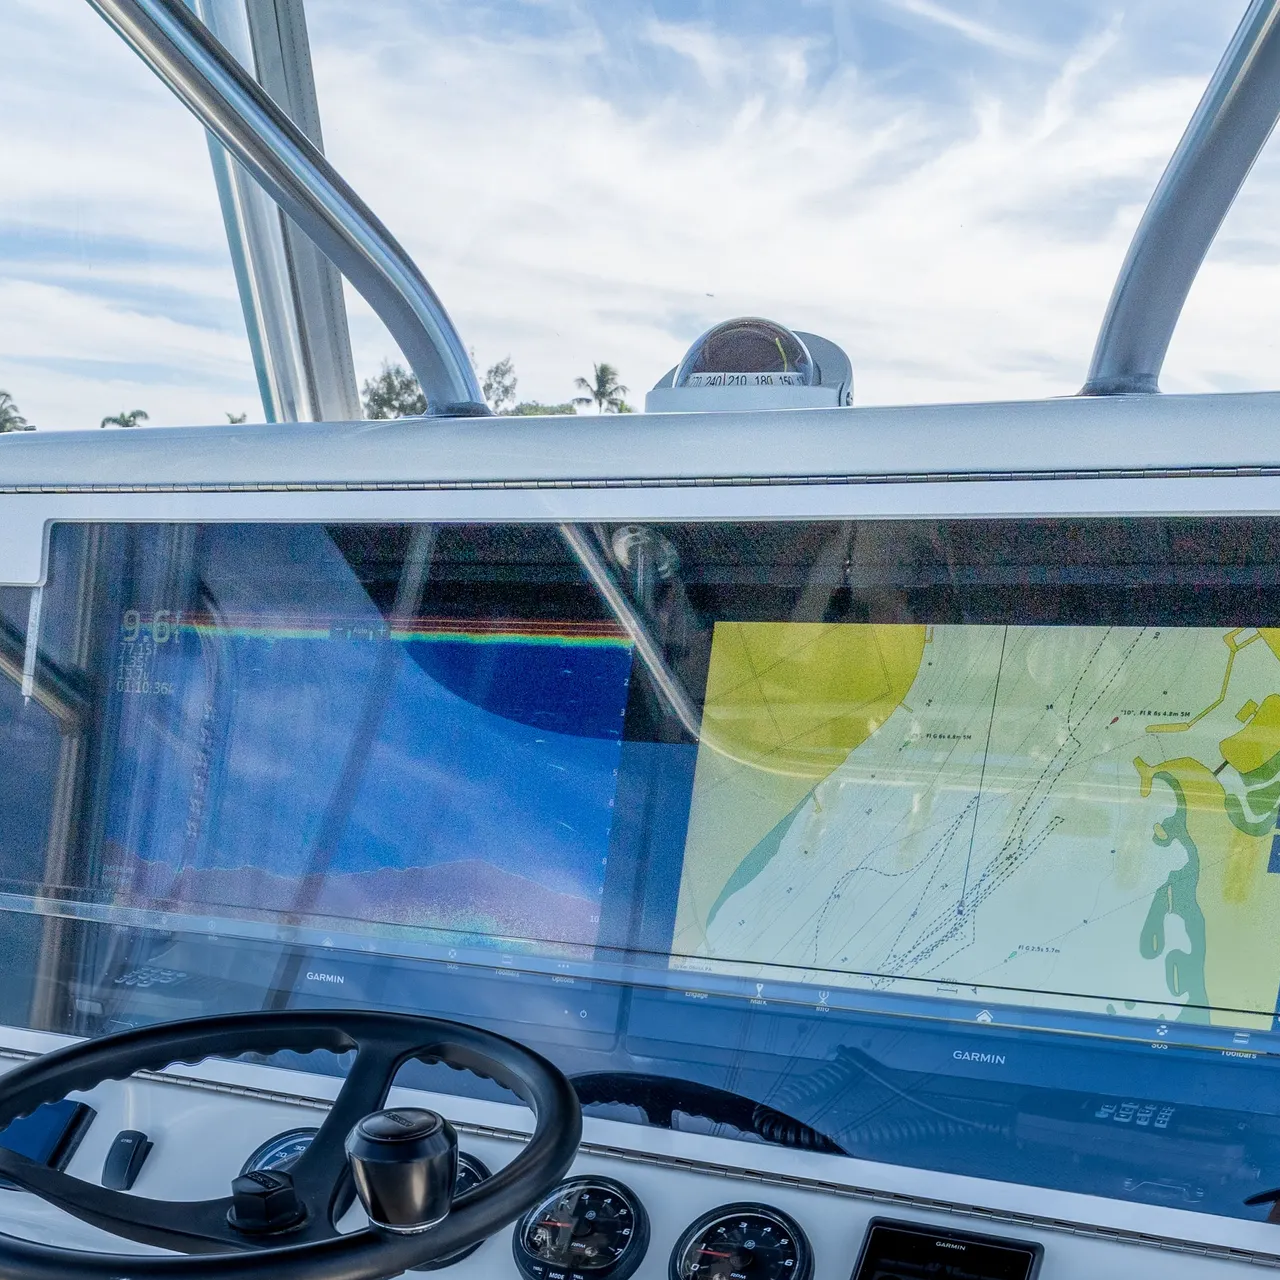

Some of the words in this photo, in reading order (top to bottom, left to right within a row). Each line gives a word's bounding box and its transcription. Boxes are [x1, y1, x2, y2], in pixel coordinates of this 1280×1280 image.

[706, 376, 722, 386] 240
[728, 376, 747, 386] 210
[755, 376, 773, 386] 180
[306, 972, 345, 984] GARMIN
[952, 1050, 1006, 1065] GARMIN
[935, 1241, 966, 1251] GARMIN
[690, 1263, 700, 1271] 0
[548, 1272, 565, 1280] MODE
[730, 1272, 747, 1280] RPM
